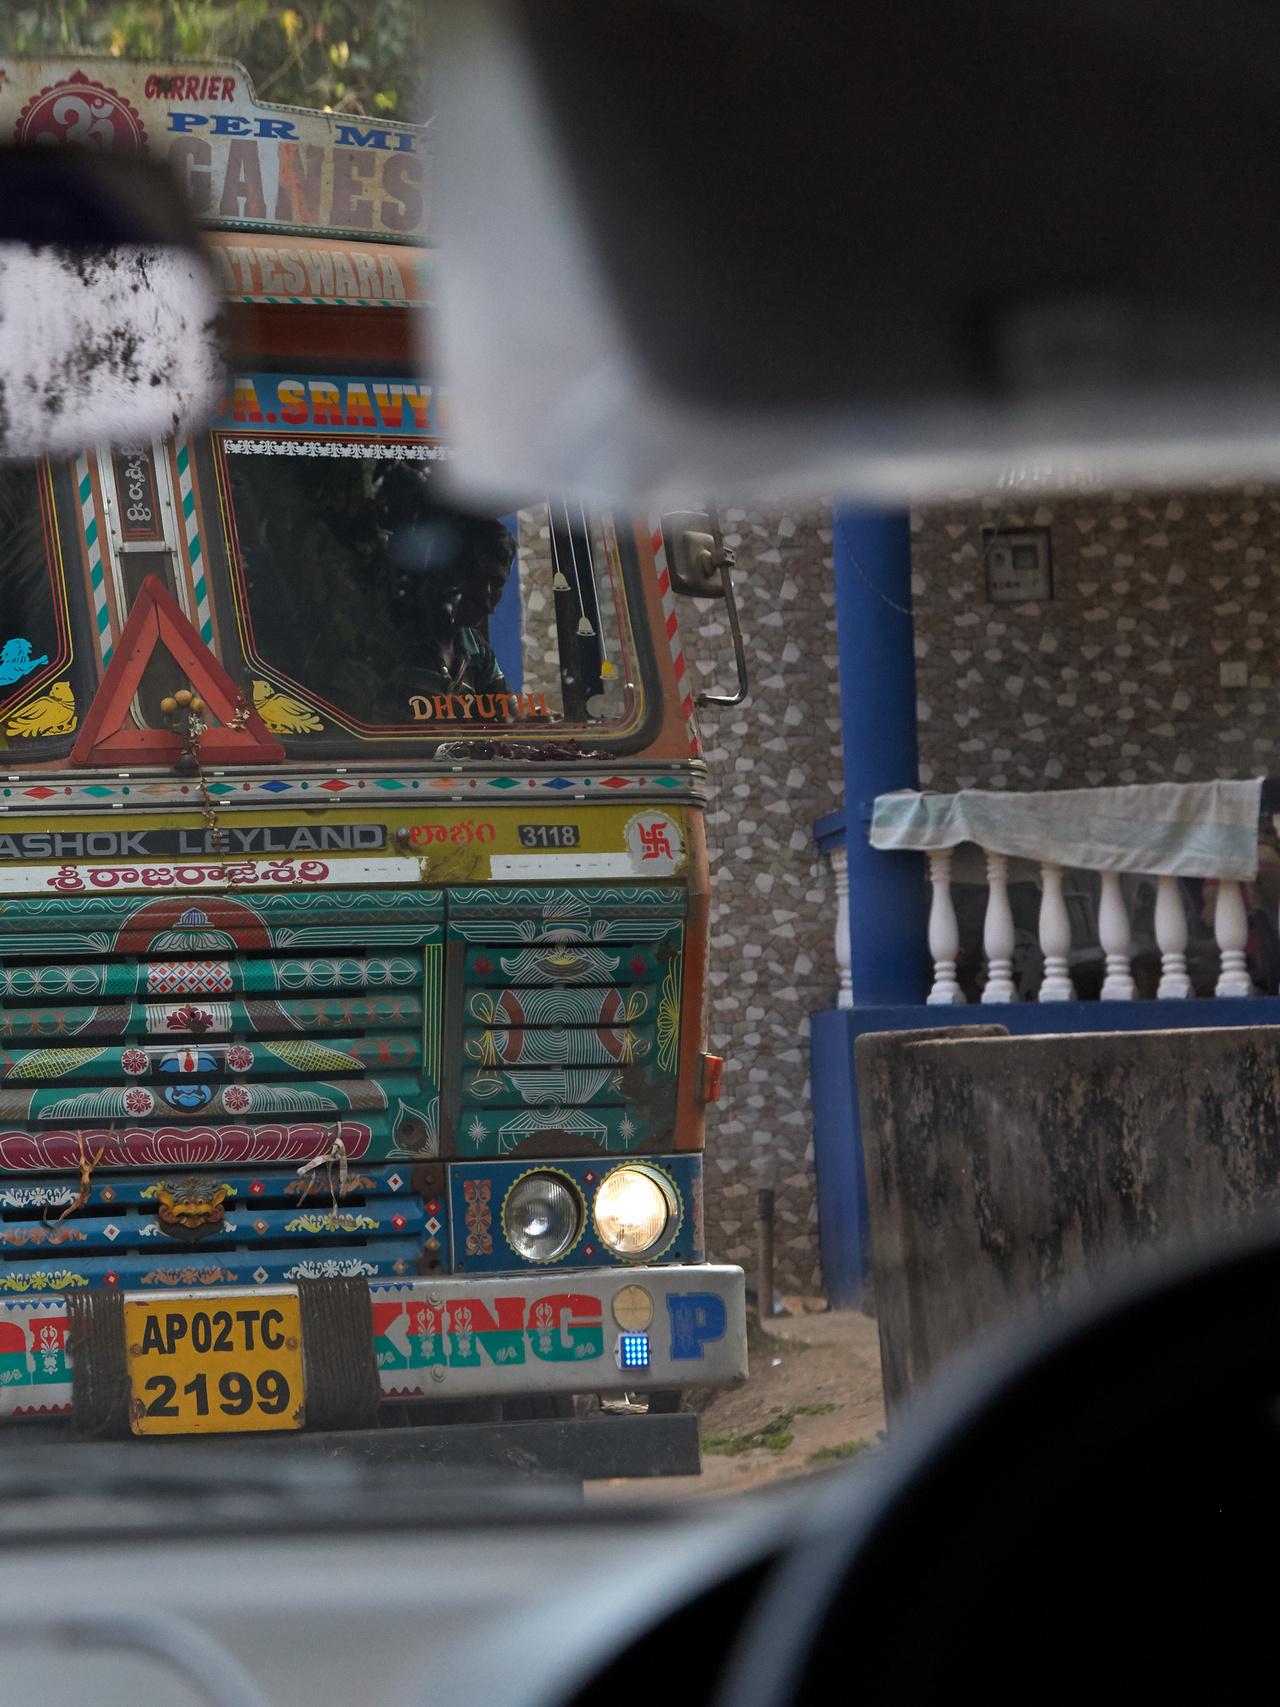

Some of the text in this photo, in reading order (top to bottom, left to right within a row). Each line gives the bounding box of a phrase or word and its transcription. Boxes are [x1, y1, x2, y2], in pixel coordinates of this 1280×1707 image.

[144, 74, 237, 103] CARRIER
[167, 112, 426, 154] PER MI
[169, 135, 426, 232] GANES
[408, 692, 549, 721] DHYUTHI
[179, 825, 385, 853] LEYLAND
[523, 825, 577, 847] 3118
[141, 1309, 286, 1355] AP02TC
[665, 1291, 728, 1361] P
[144, 1369, 291, 1418] 2199
